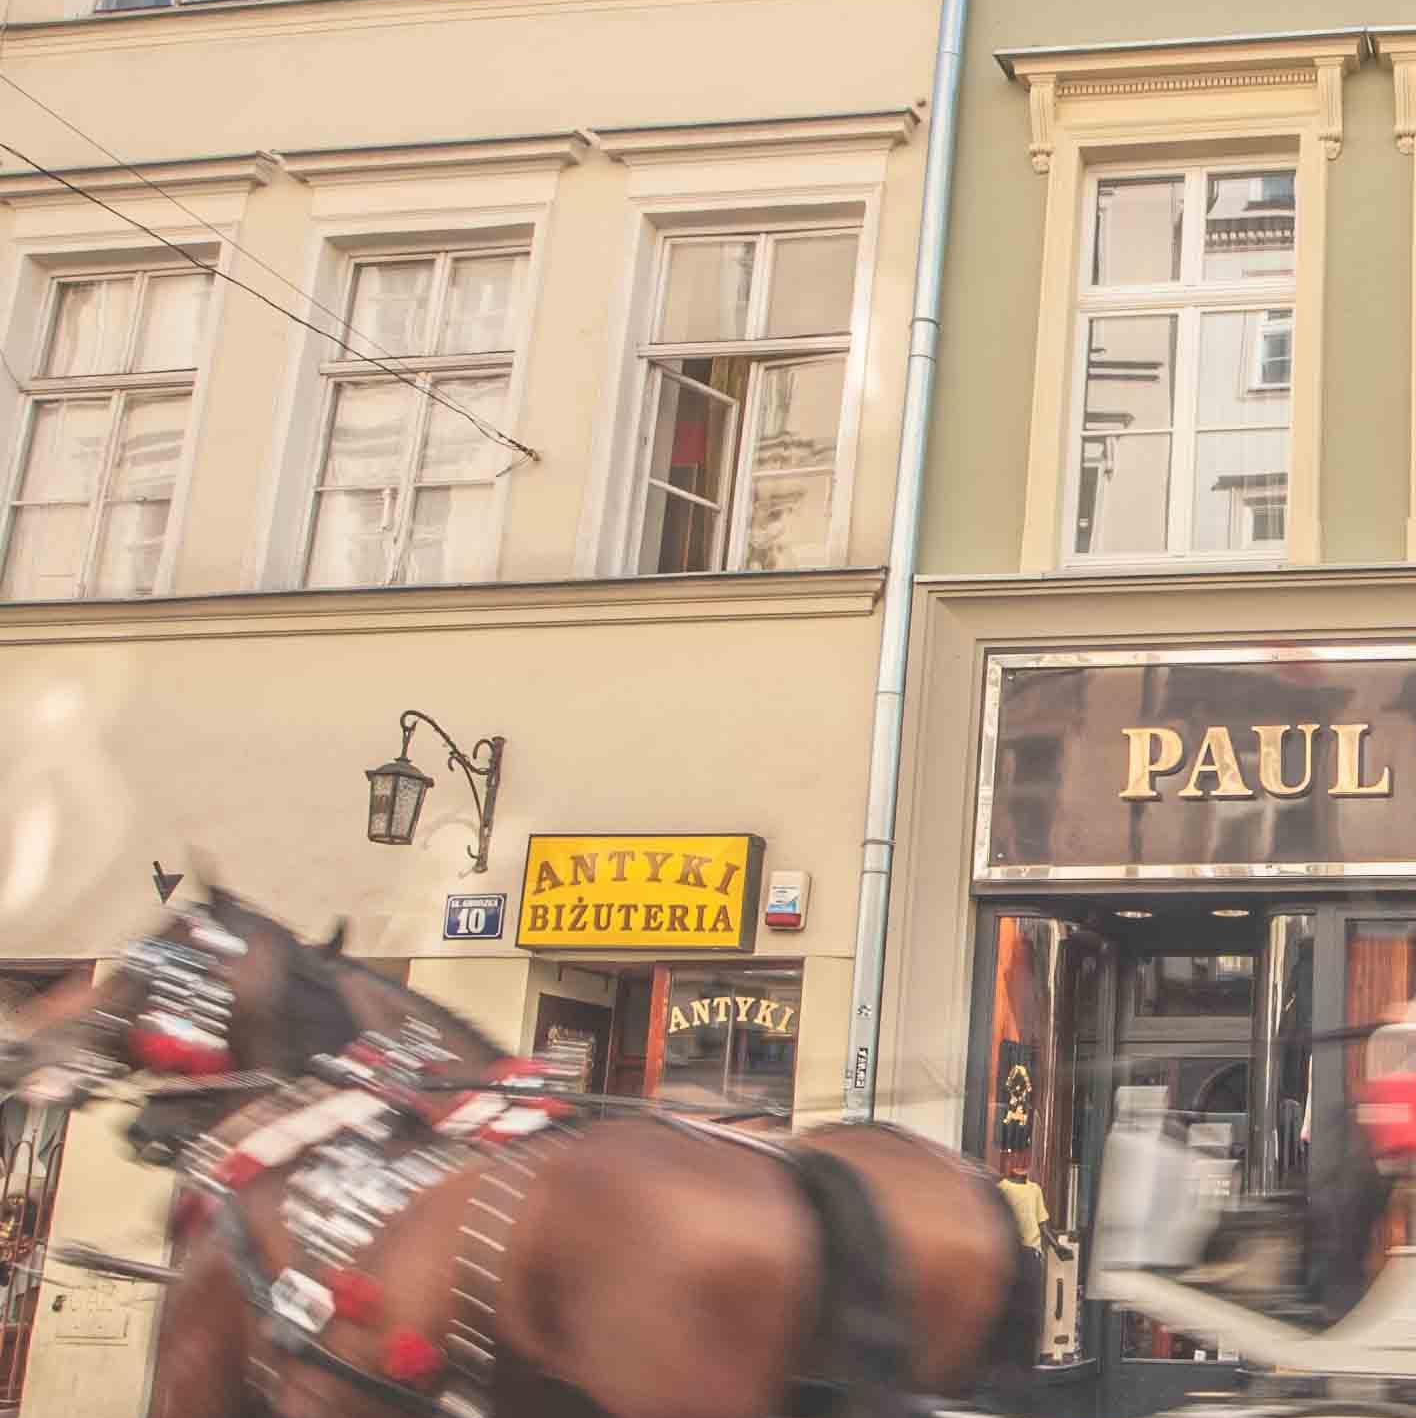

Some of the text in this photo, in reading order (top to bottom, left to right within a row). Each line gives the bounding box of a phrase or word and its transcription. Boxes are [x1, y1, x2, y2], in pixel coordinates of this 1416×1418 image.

[1118, 723, 1392, 801] PAUL
[531, 850, 741, 896] ANTYKI
[456, 908, 486, 934] 10
[527, 896, 735, 932] BIŻUTERIA
[668, 996, 795, 1034] ANTYKI
